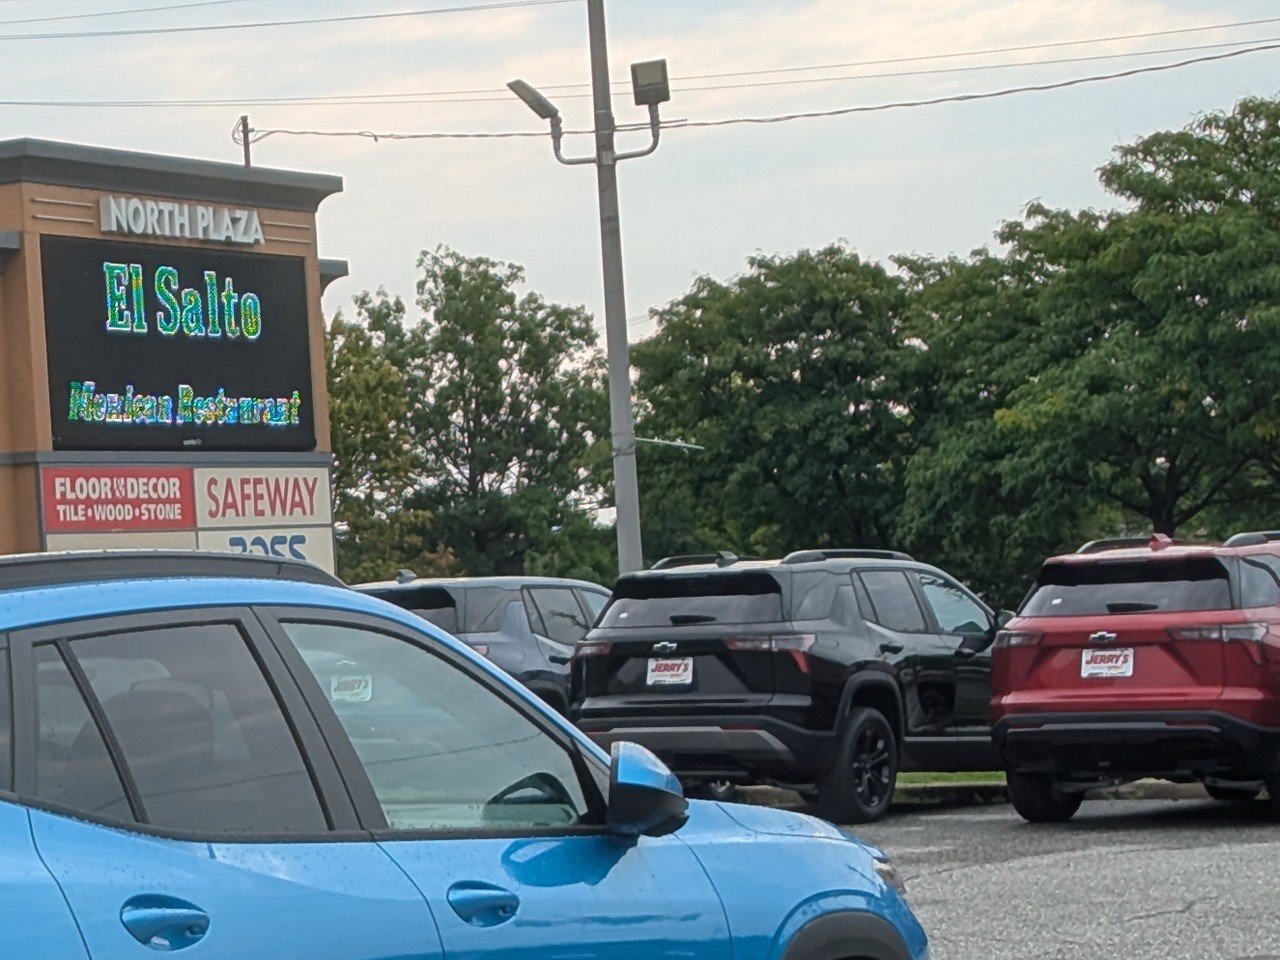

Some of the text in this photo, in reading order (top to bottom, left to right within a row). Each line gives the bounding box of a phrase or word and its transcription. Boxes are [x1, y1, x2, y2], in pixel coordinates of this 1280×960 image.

[101, 195, 266, 245] NORTH PLAZA
[103, 261, 262, 339] El Salto
[68, 380, 301, 426] Mexican Restaurant
[54, 477, 112, 500] FLOOR
[126, 477, 181, 500] DECOR
[206, 476, 318, 519] SAFEWAY
[56, 503, 182, 522] TILE WOOD STONE
[651, 662, 689, 673] JERRY'S
[1085, 654, 1129, 665] JERRY'S
